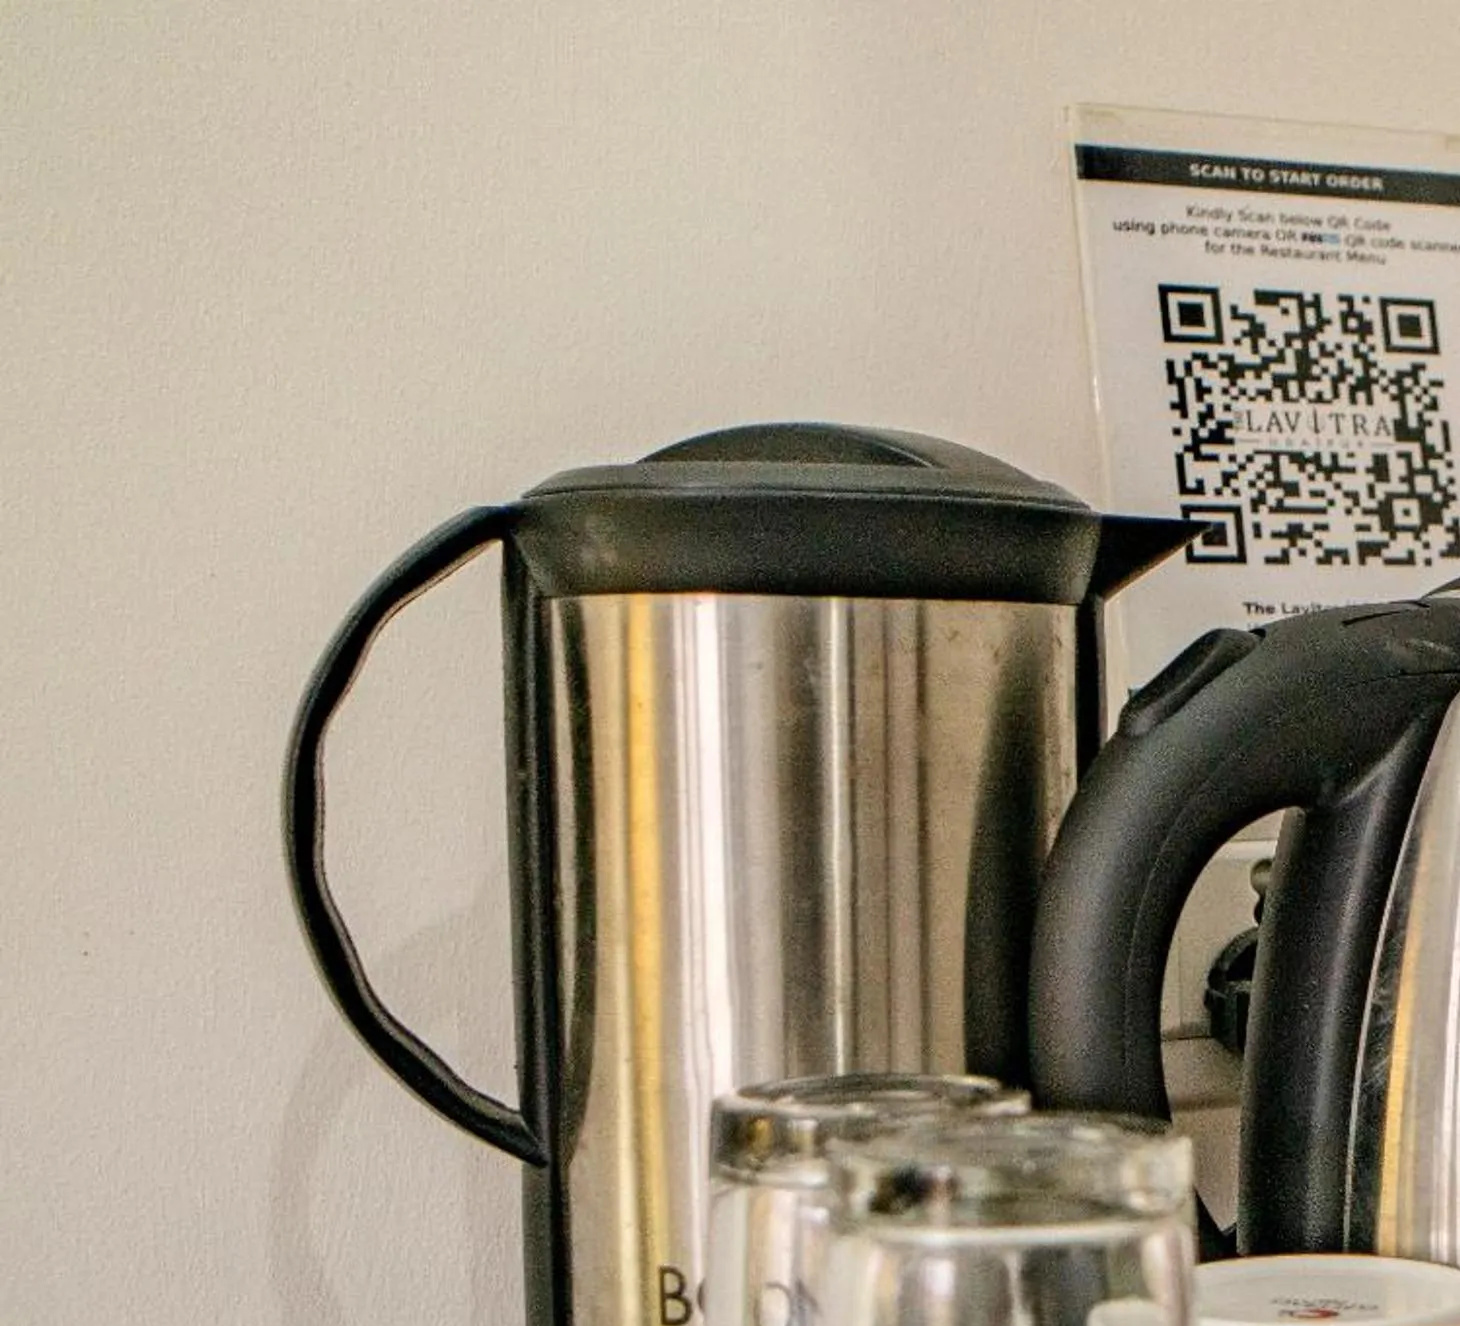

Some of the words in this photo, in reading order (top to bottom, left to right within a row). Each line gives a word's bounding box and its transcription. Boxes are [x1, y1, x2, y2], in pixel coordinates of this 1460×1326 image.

[1189, 162, 1237, 180] SCAN
[1241, 166, 1265, 182] TO
[1269, 168, 1321, 186] START
[1326, 173, 1385, 191] ORDER
[1186, 204, 1233, 222] Kindly
[1238, 207, 1275, 223] Scan
[1280, 212, 1323, 228] below
[1327, 214, 1348, 230] QR
[1354, 217, 1392, 232] Code
[1112, 218, 1156, 236] using
[1160, 221, 1209, 237] phone
[1214, 226, 1271, 242] camera
[1275, 227, 1297, 243] OR
[1345, 233, 1366, 249] QR
[1370, 235, 1405, 250] code
[1204, 239, 1226, 255] for
[1230, 242, 1256, 256] the
[1260, 243, 1341, 263] Restaurant
[1346, 249, 1388, 266] Menu
[1242, 602, 1275, 616] The
